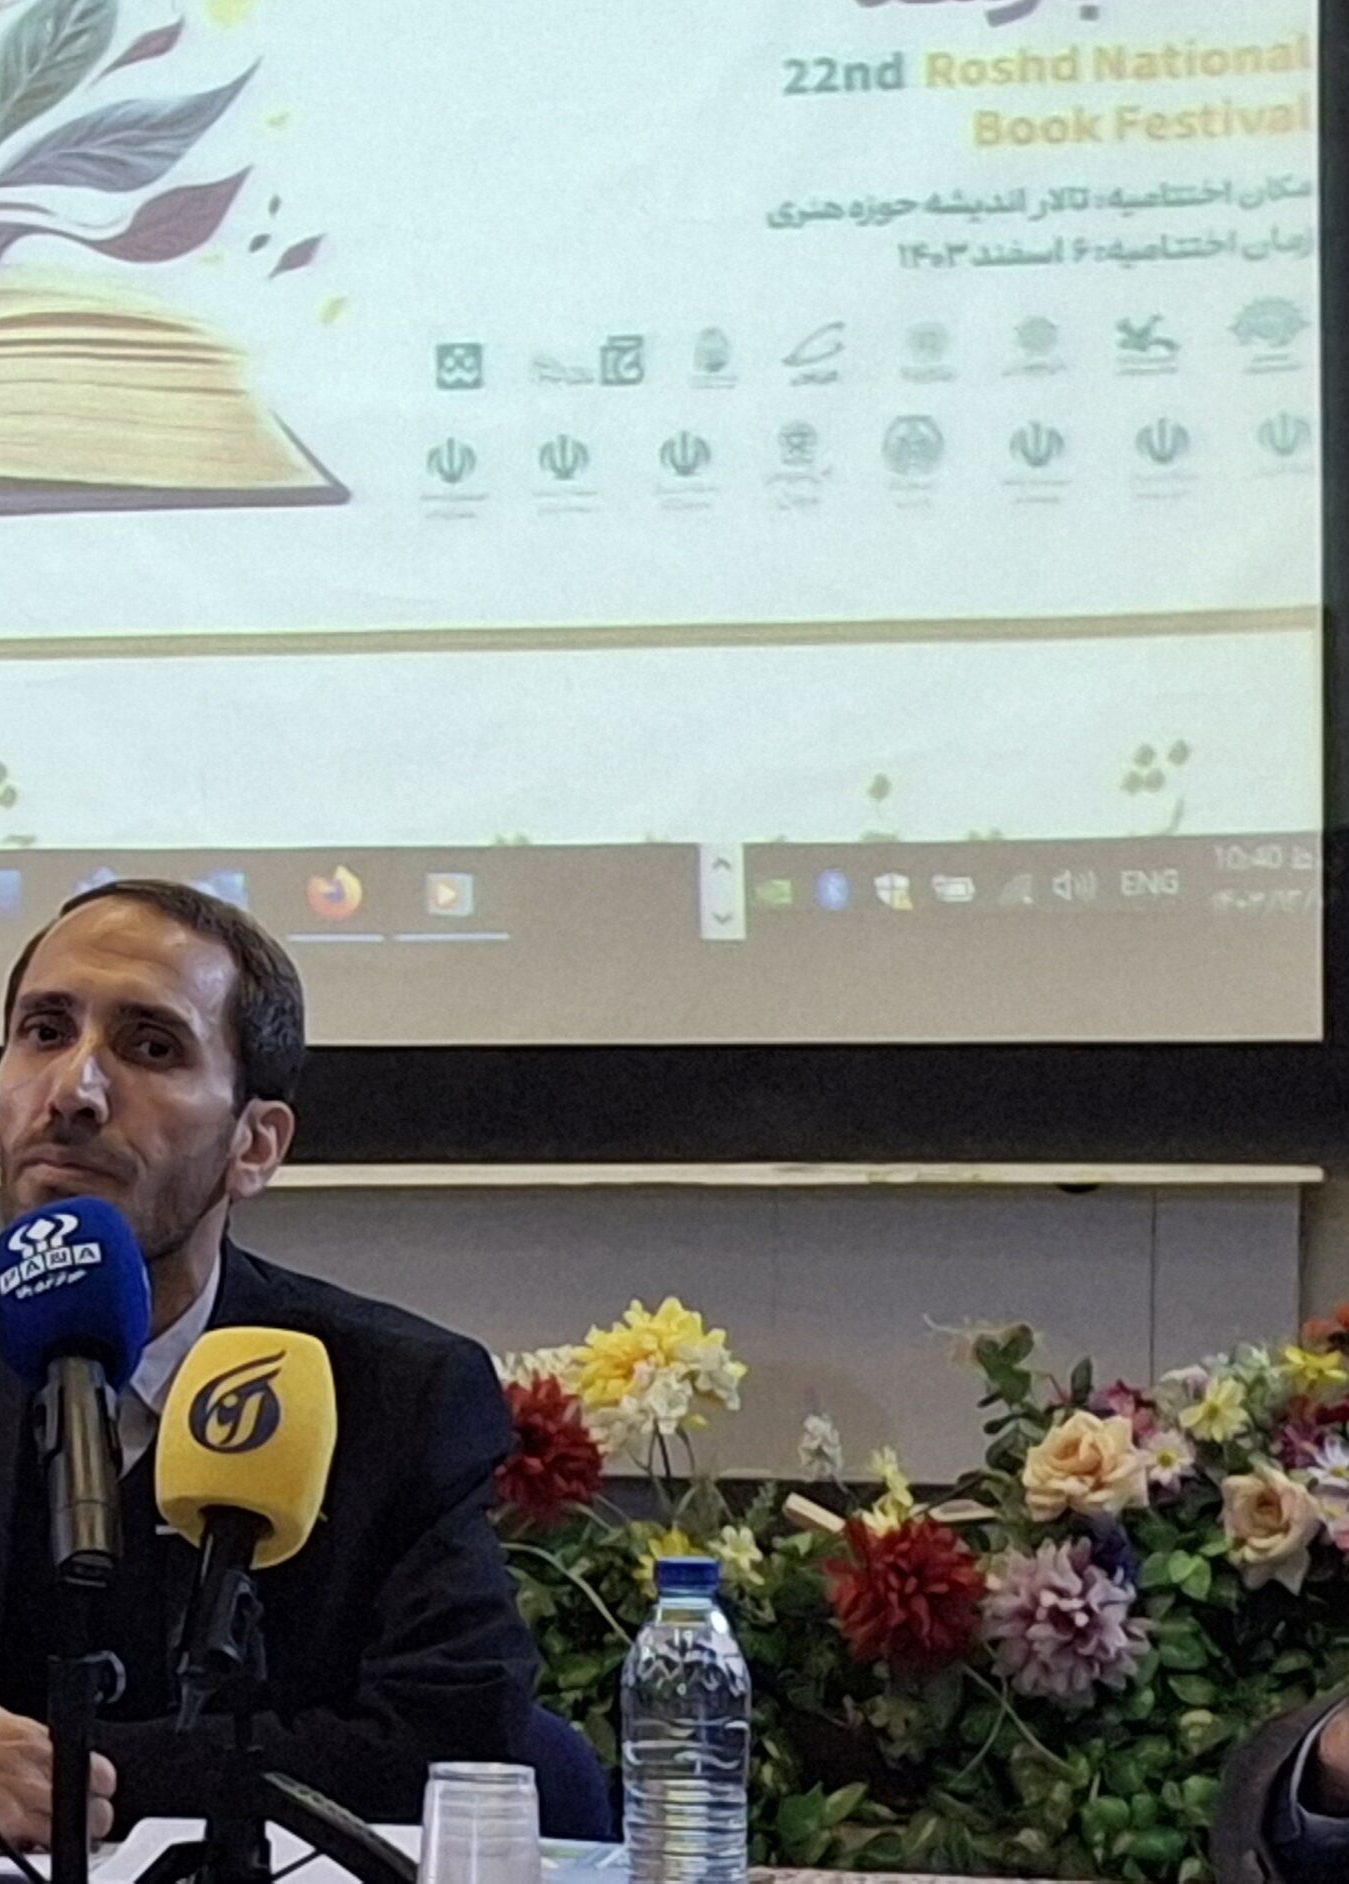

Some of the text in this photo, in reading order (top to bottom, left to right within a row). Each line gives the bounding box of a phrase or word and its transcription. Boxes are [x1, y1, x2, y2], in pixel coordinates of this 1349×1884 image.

[783, 33, 1311, 95] 22nd Roshd National
[973, 92, 1311, 147] Book Festival
[765, 198, 846, 229] هنری
[848, 196, 918, 227] حوزه
[922, 187, 1027, 224] اندیشه
[1025, 185, 1089, 222] تالار
[970, 234, 1064, 268] اسفند
[1120, 868, 1179, 896] ENG
